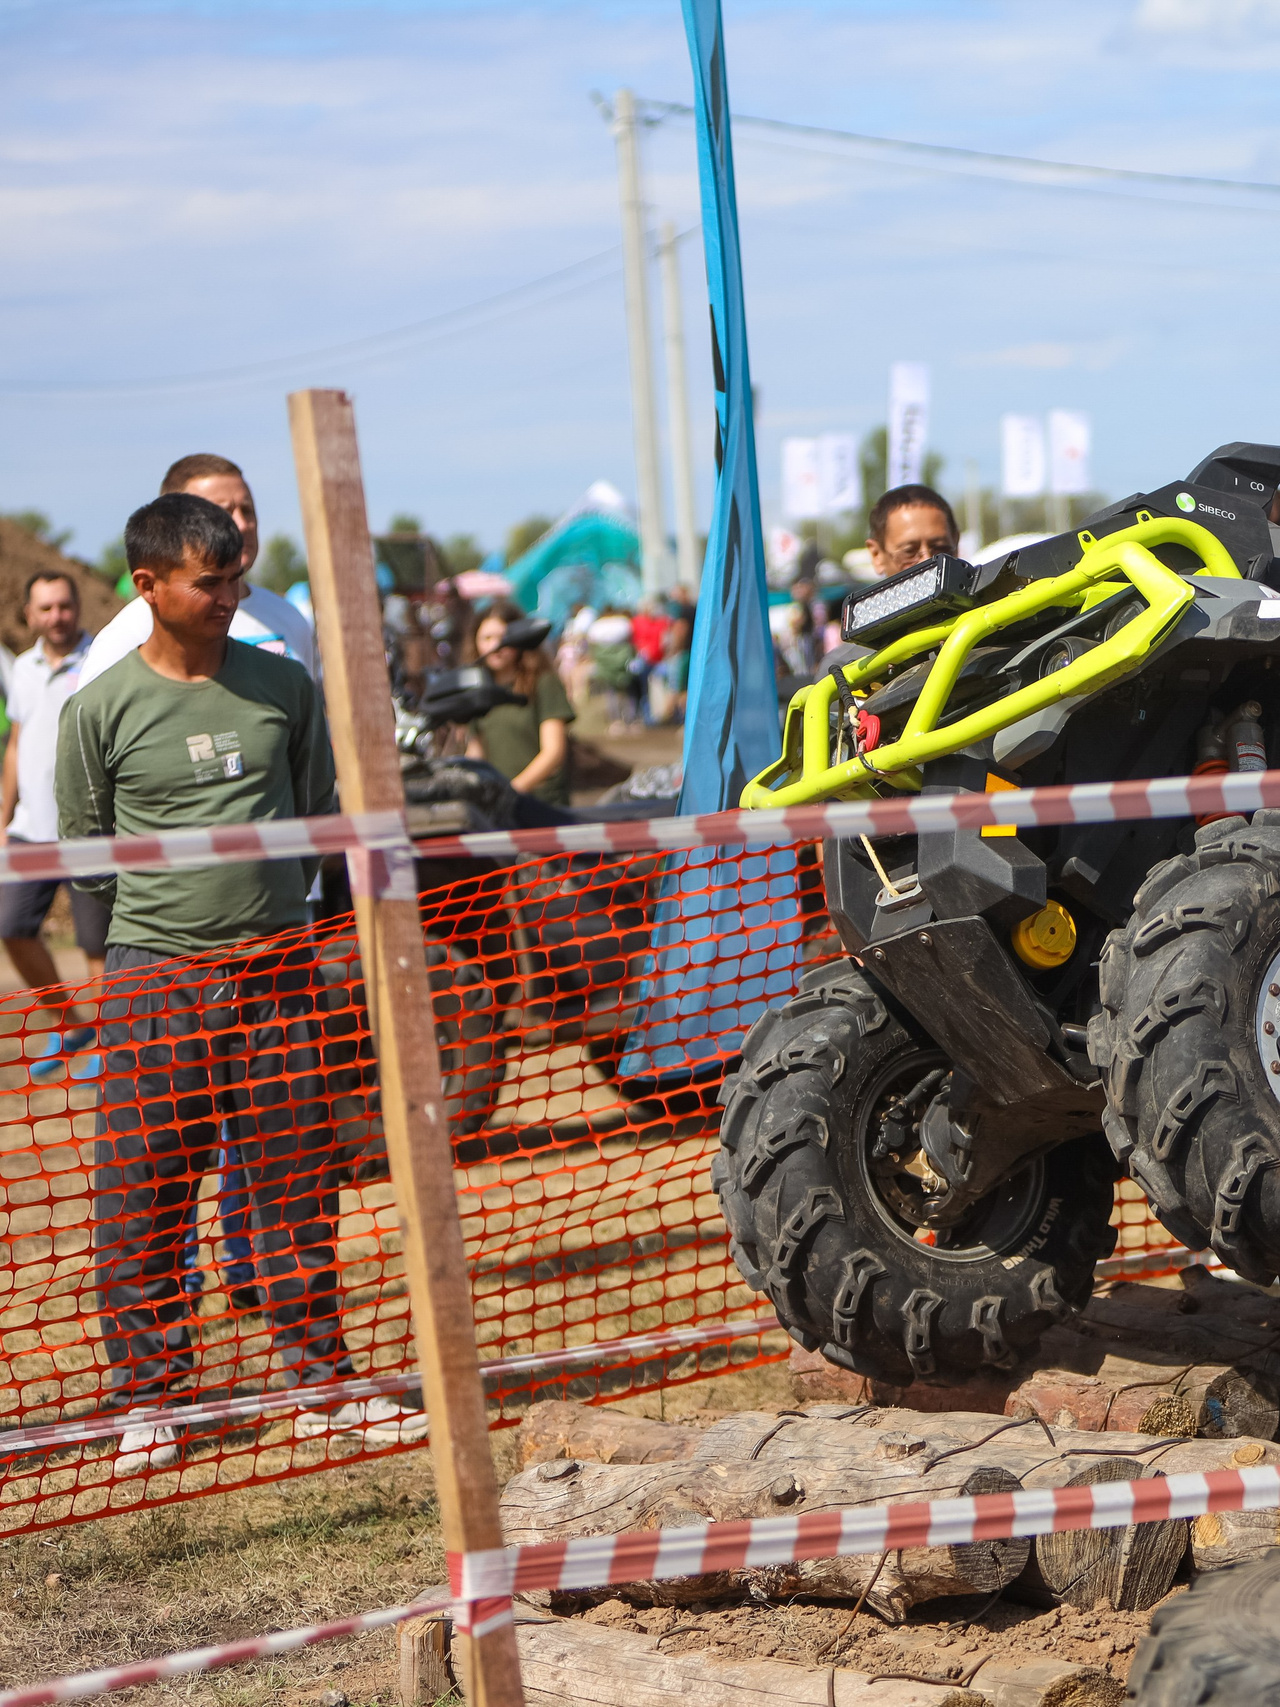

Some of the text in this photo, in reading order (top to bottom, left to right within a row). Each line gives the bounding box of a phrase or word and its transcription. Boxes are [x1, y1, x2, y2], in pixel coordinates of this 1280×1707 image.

[1198, 503, 1236, 521] SIBECO
[1001, 1197, 1064, 1270] WILD THANG
